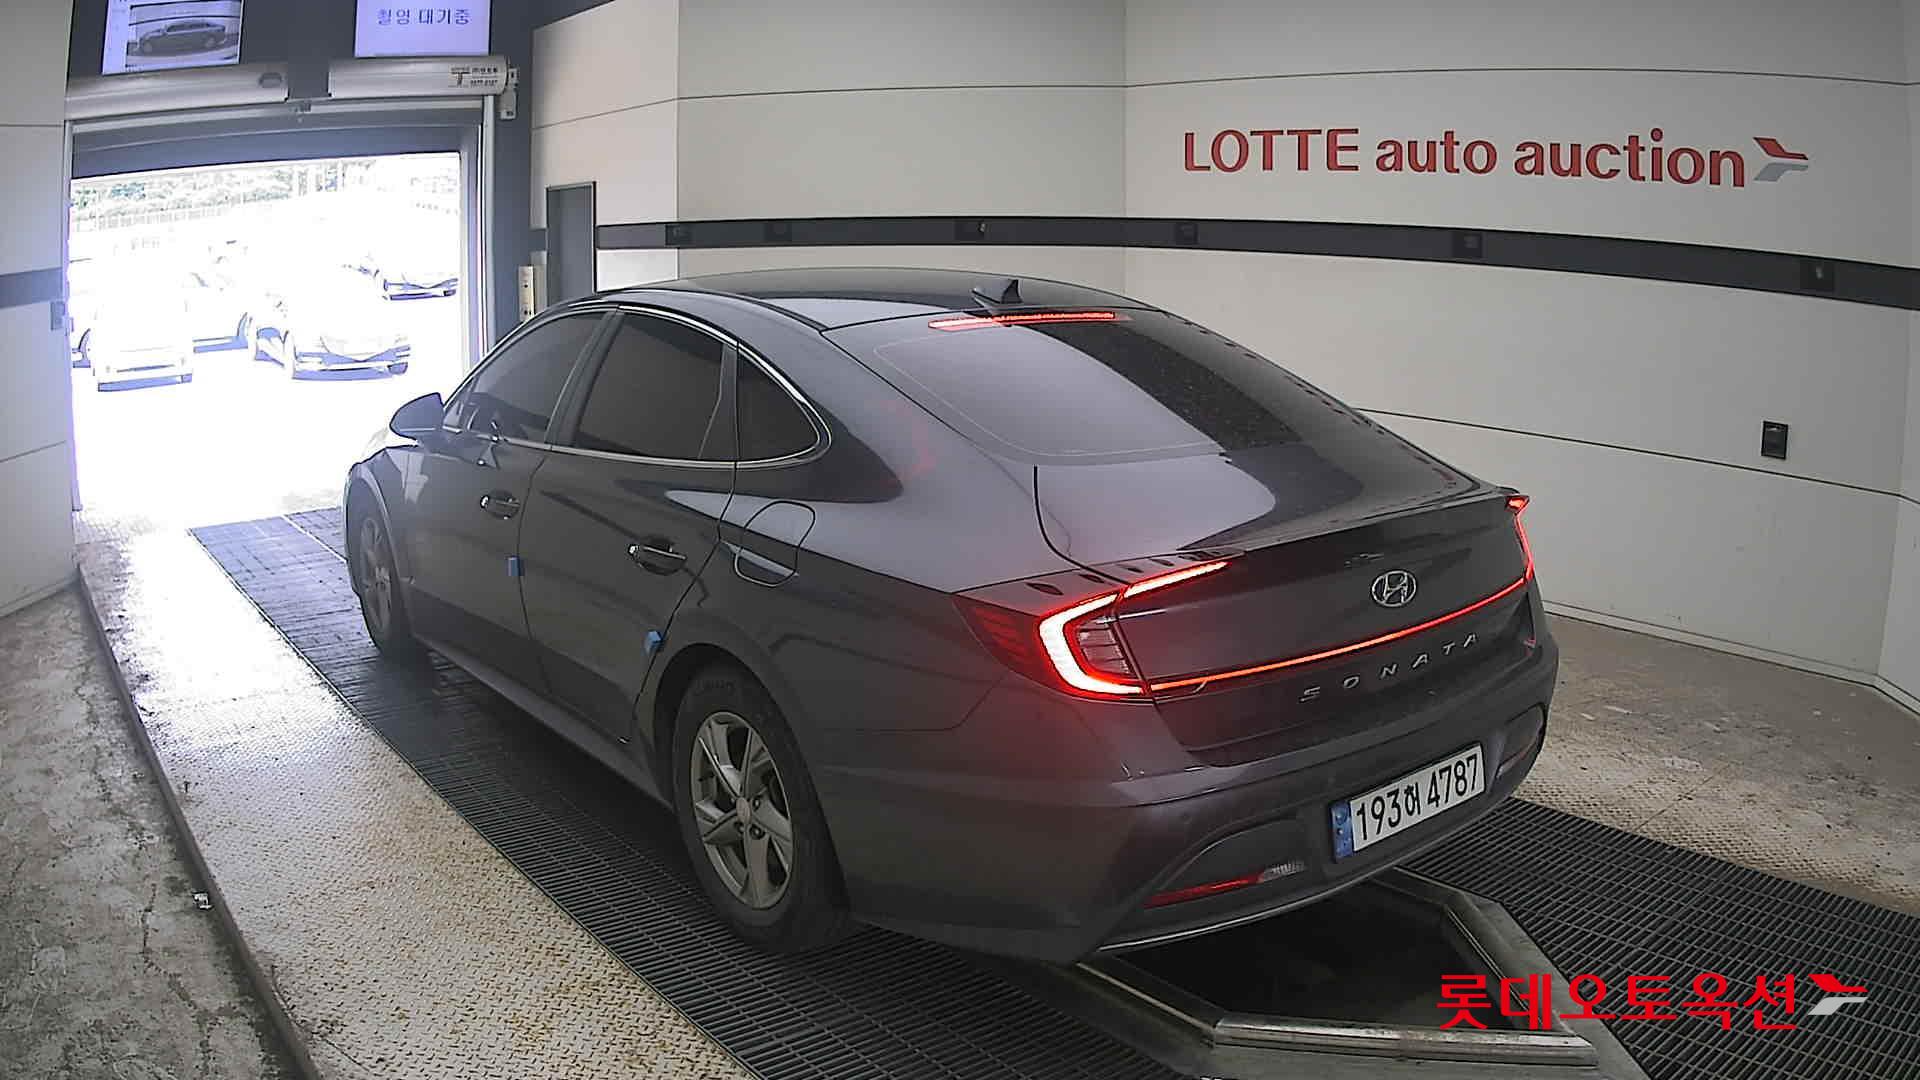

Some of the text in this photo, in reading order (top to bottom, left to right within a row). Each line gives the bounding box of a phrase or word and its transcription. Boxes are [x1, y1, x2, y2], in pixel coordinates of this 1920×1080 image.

[419, 9, 470, 25] 대기중
[1185, 128, 1745, 188] LOTTE auto auction
[1300, 633, 1477, 702] SONATA
[1428, 754, 1478, 809] 4787
